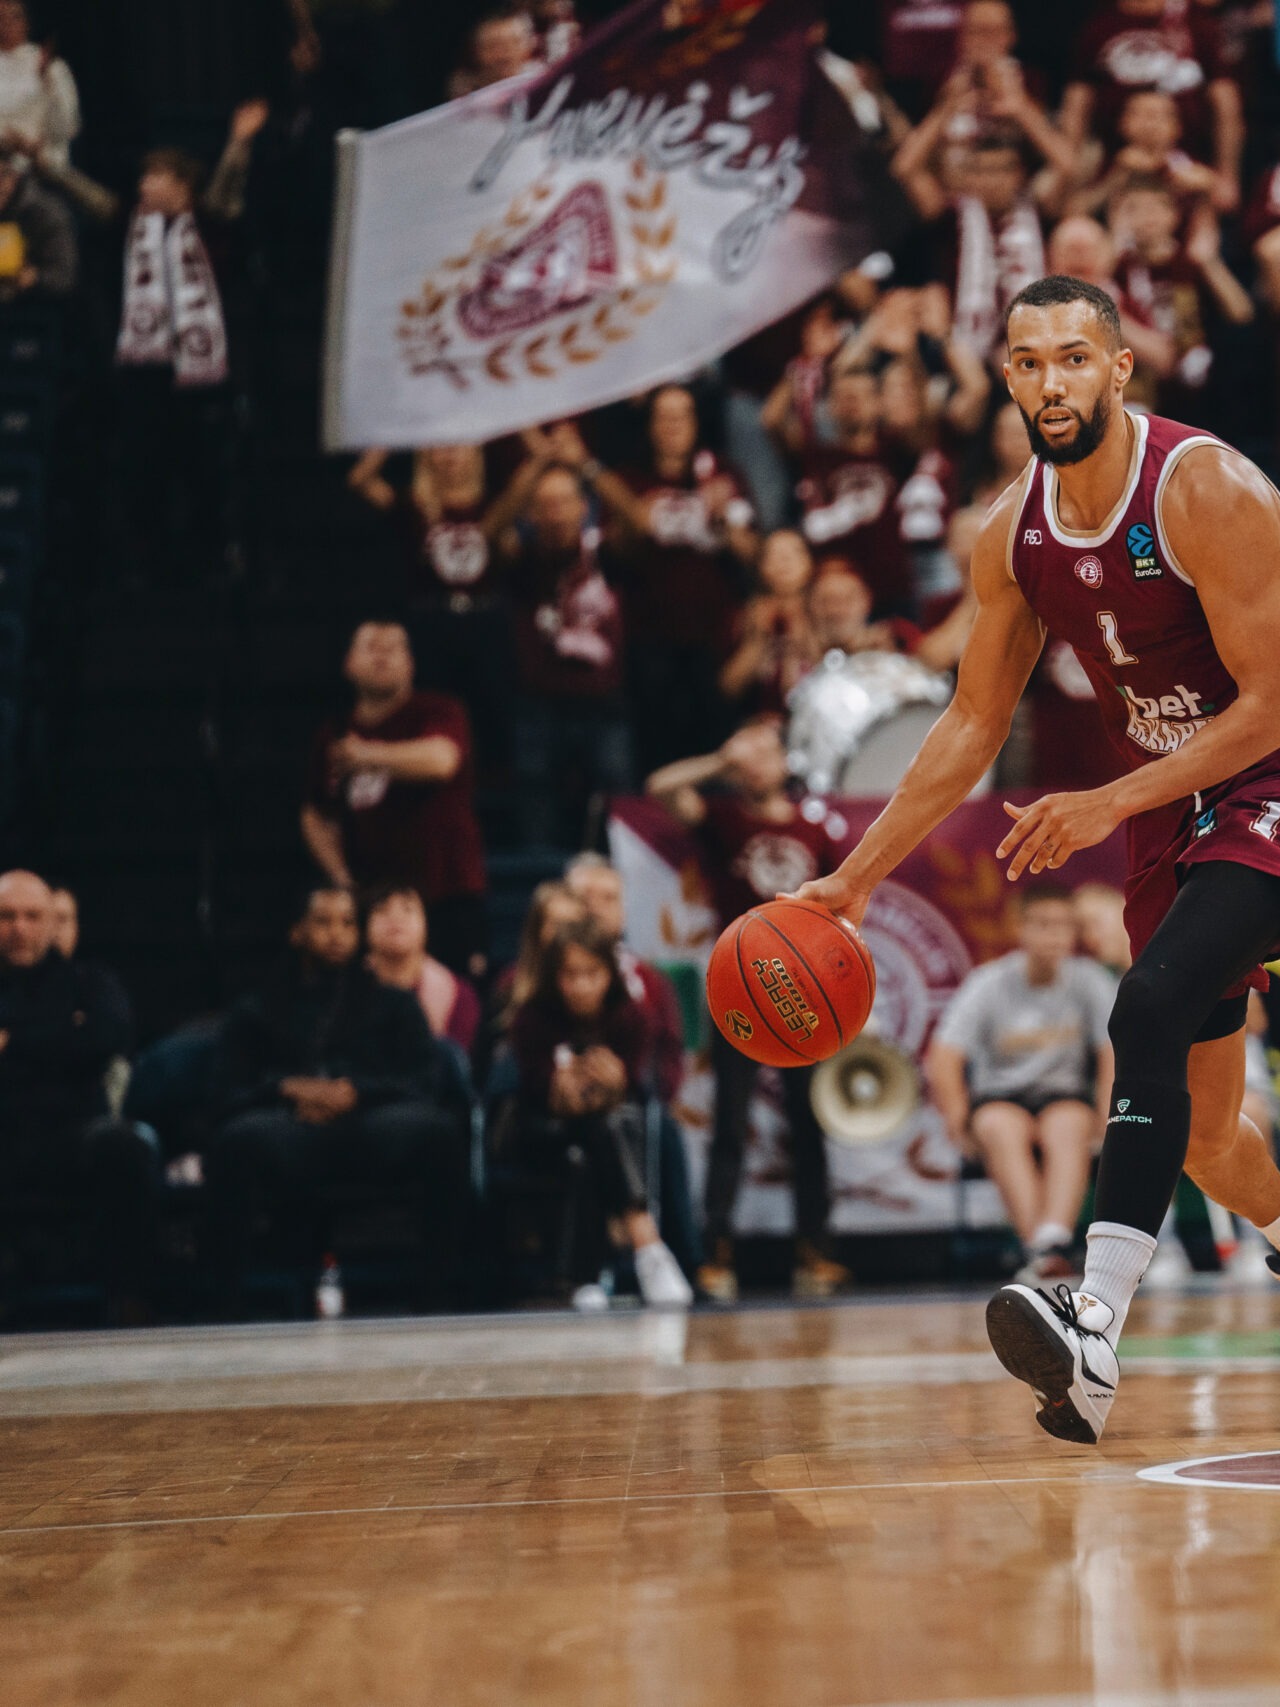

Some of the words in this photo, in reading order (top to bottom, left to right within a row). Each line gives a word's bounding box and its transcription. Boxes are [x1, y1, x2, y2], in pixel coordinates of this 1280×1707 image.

[1135, 558, 1156, 568] BKT
[1135, 568, 1163, 578] EuroCup
[1097, 611, 1139, 666] 1
[751, 957, 814, 1043] LEGACY
[771, 958, 808, 1012] 1000
